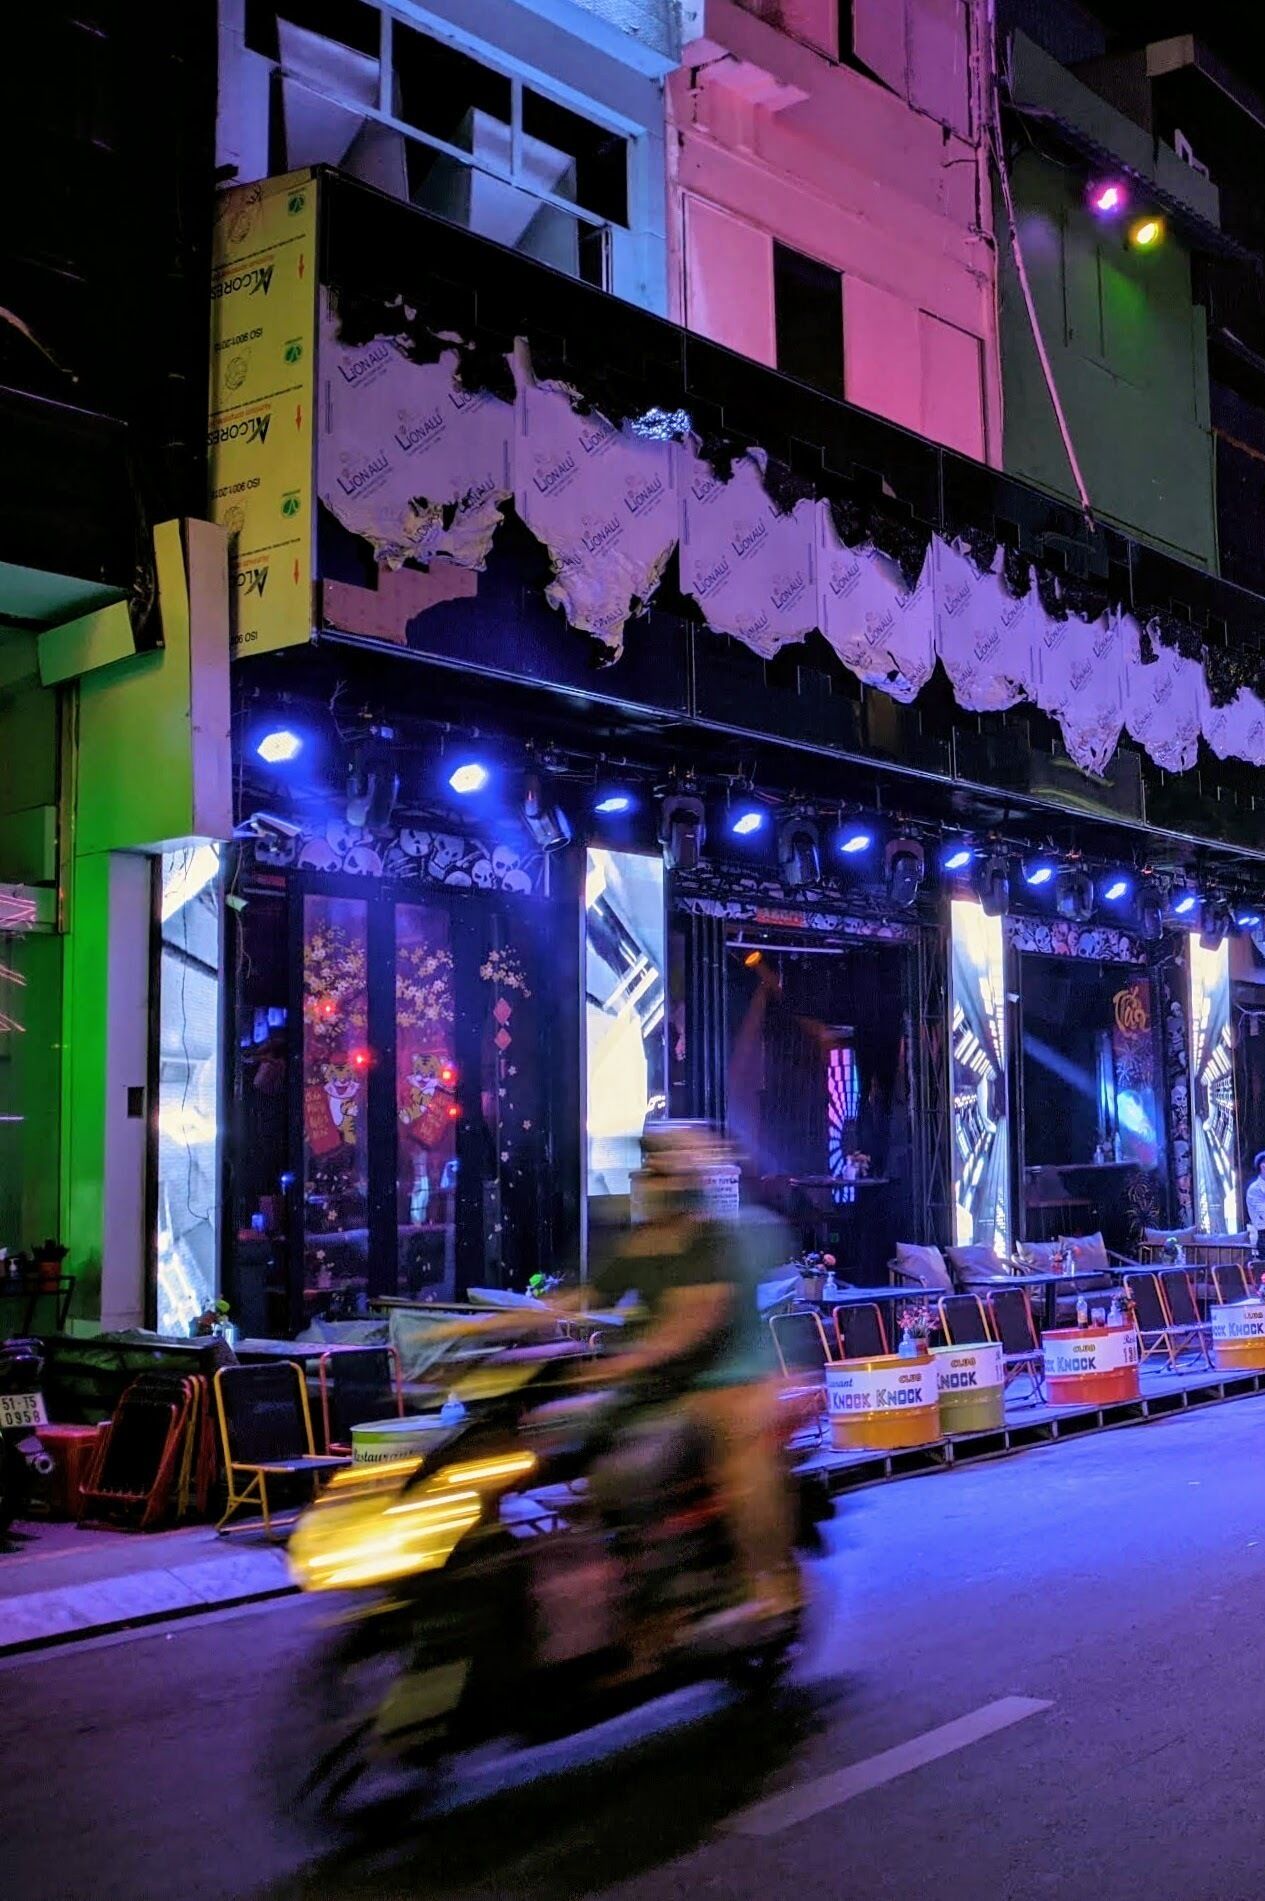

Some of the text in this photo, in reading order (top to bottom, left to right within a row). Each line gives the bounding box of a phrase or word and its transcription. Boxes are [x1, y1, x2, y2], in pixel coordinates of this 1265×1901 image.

[244, 631, 258, 642] ISO
[1228, 1322, 1265, 1337] KNOCK
[1056, 1356, 1097, 1373] KNOCK
[832, 1387, 924, 1411] KNOCK KNOCK
